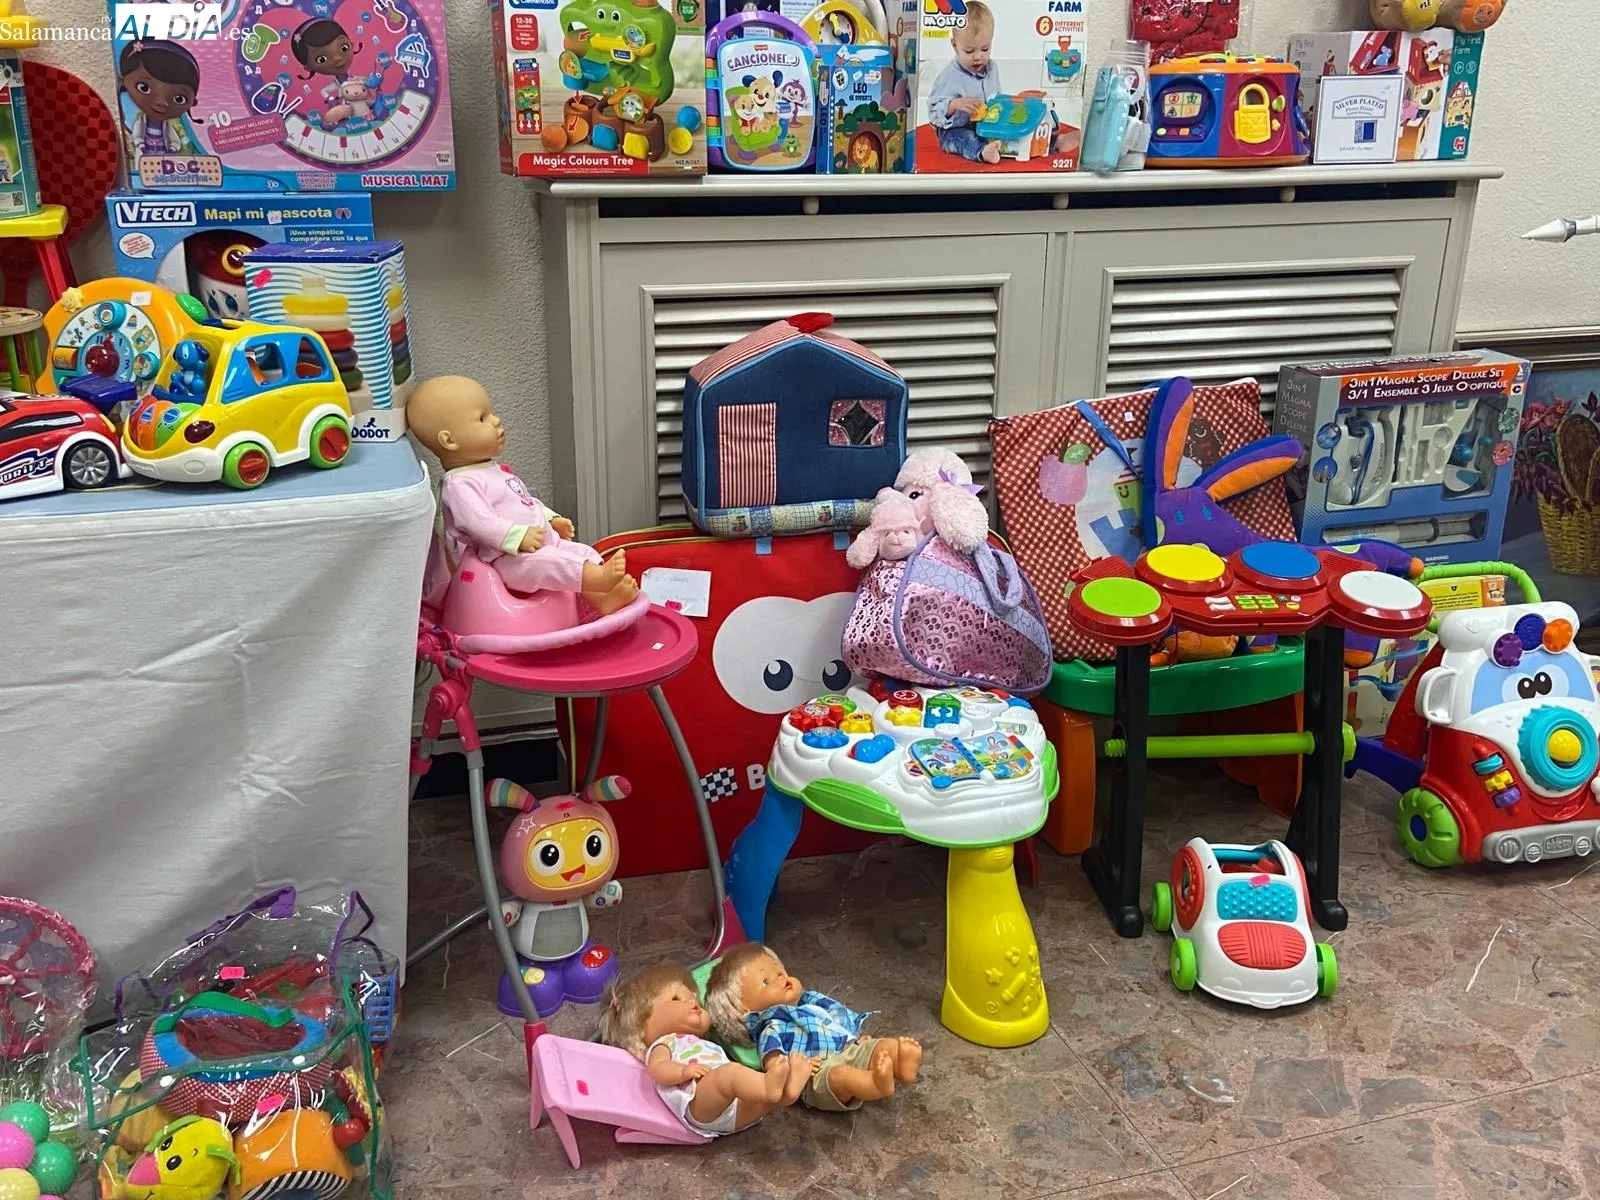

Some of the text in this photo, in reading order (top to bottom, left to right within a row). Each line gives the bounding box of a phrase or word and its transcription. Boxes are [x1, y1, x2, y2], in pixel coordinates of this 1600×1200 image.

[1048, 1, 1082, 12] FARM
[924, 16, 967, 28] MOLTO
[727, 53, 801, 70] CANCIONE
[853, 83, 867, 94] LEO
[1336, 99, 1358, 111] SILVER
[1360, 98, 1384, 110] PLATED
[209, 110, 232, 128] 10
[160, 159, 201, 175] DOC
[533, 155, 634, 169] Magic Colours Tree
[1053, 159, 1073, 168] 5221
[362, 174, 448, 187] MUSICAL MAT
[120, 202, 189, 222] VTECH
[204, 208, 240, 222] Mapi
[245, 207, 264, 219] mi
[1376, 376, 1415, 386] MAGNA
[1417, 372, 1448, 384] SCOPE
[1452, 369, 1487, 380] DELUXE
[1489, 367, 1506, 378] SET
[1281, 390, 1312, 409] MAGNA
[1347, 388, 1368, 400] 3/1
[1373, 386, 1419, 399] ENSEMBLE
[1421, 384, 1431, 394] 3
[1432, 383, 1454, 393] JEUX
[1283, 403, 1308, 420] SCOPE
[1280, 415, 1309, 433] DELUXE
[351, 427, 391, 439] DODOT
[2, 457, 49, 482] DRIFT
[746, 763, 766, 790] B
